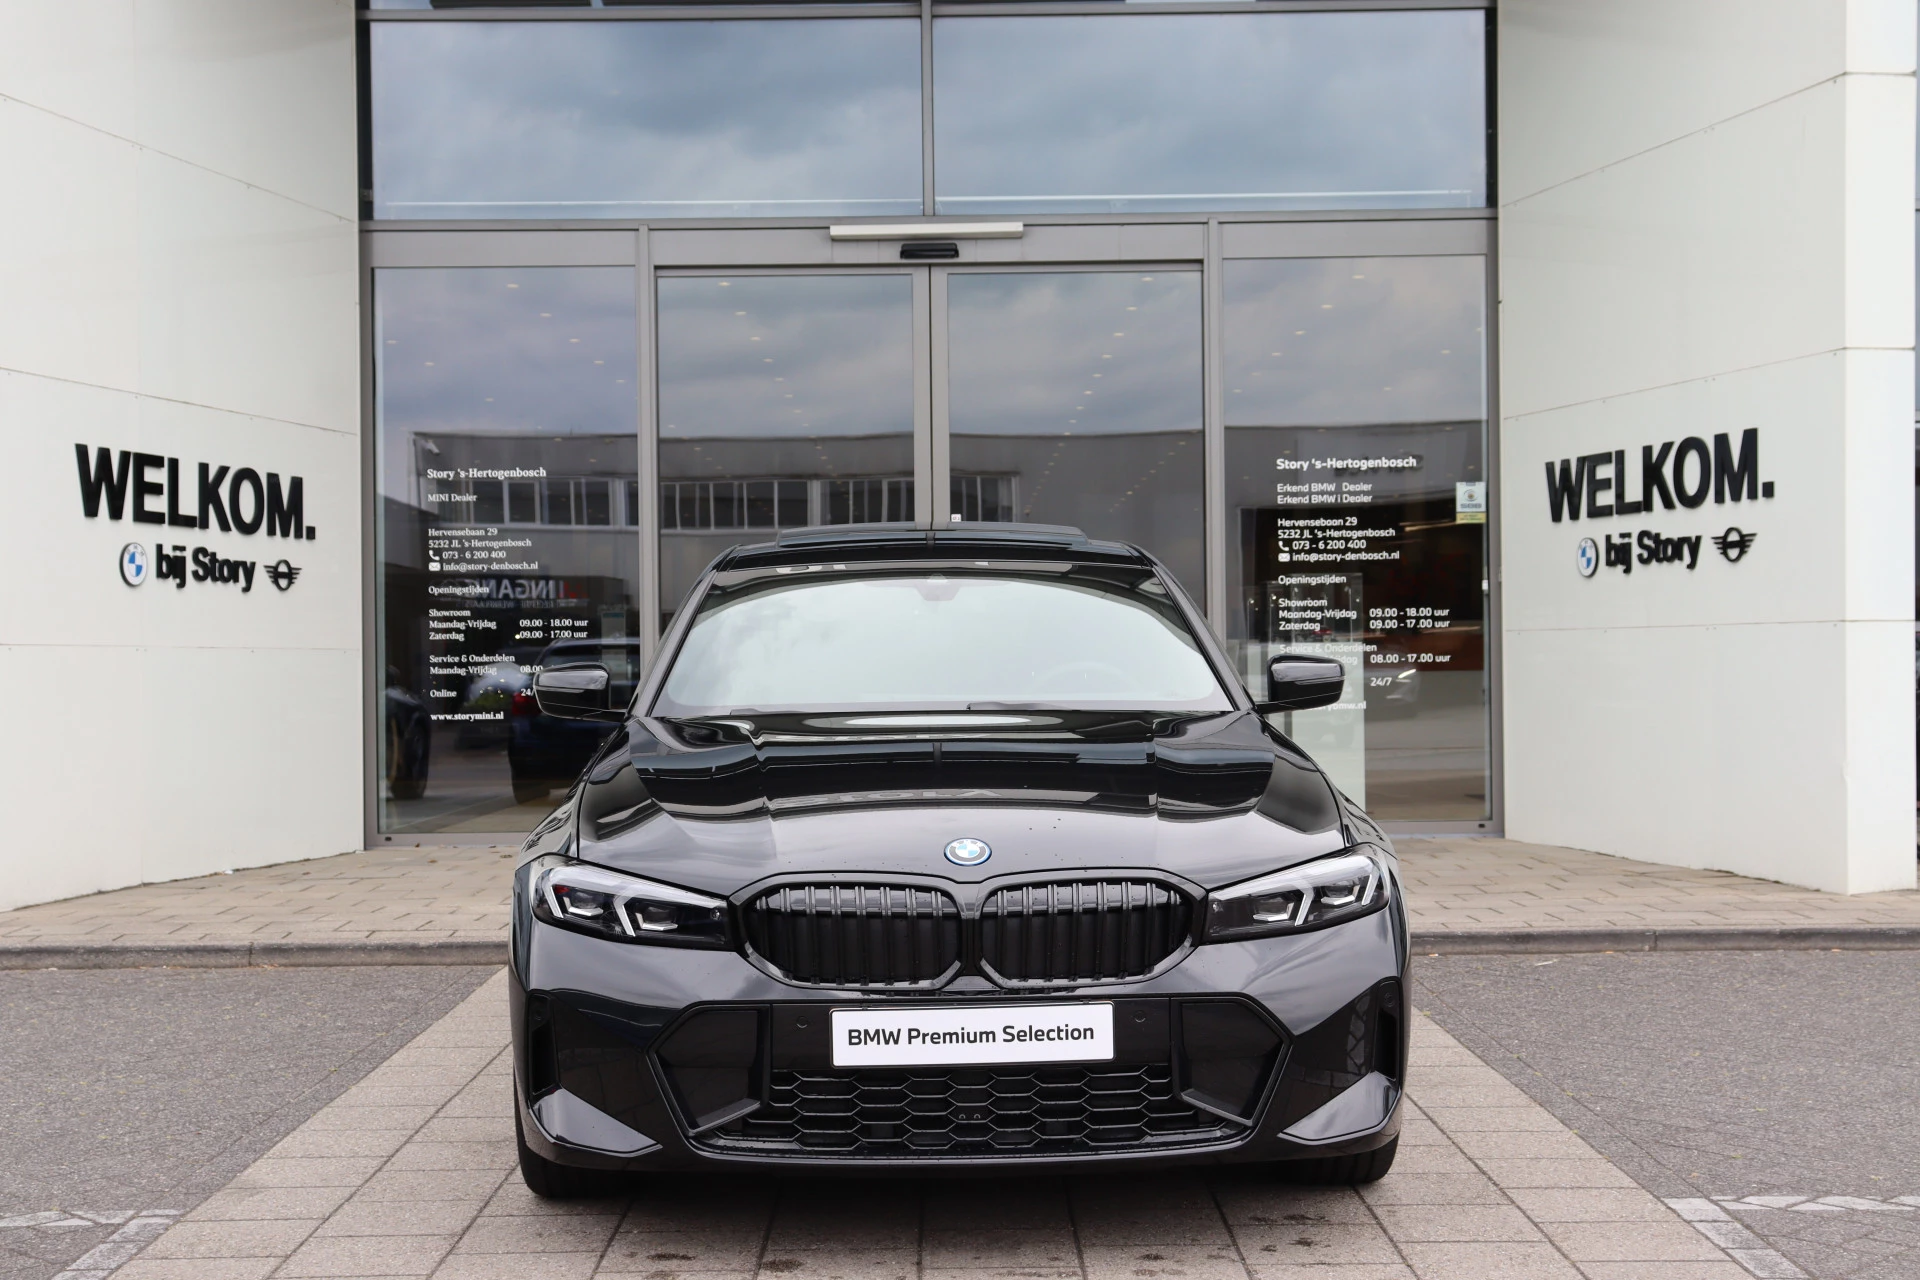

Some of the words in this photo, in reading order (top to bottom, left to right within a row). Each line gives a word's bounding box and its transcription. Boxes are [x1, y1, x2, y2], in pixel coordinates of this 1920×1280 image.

[1276, 458, 1309, 471] Story
[427, 468, 455, 480] Story
[1545, 428, 1775, 523] WELKOM.
[74, 443, 316, 540] WELKOM.
[1277, 484, 1309, 492] Erkend
[1311, 483, 1335, 492] BMW
[1342, 483, 1372, 491] Dealer
[1277, 495, 1309, 504] Erkend
[1311, 495, 1337, 503] BMW
[1343, 494, 1372, 503] Dealer
[1278, 518, 1343, 527] Hervensebaan
[1345, 518, 1357, 526] 29
[1278, 530, 1300, 538] 5232
[1303, 530, 1312, 538] JL
[1293, 541, 1310, 550] 073
[1319, 541, 1324, 549] 6
[1327, 541, 1345, 549] 200
[1347, 540, 1366, 548] 400
[1293, 551, 1400, 562] info@story-denbosch.nl
[1605, 532, 1632, 574] bij
[1637, 530, 1702, 570] Story
[156, 544, 186, 588] bij
[192, 547, 256, 592] Story
[443, 562, 538, 572] info@story-denbosch.nl
[1278, 575, 1346, 585] Openingstijden
[429, 586, 489, 595] Openingstijden
[1279, 610, 1357, 620] Maandag-Vrijdag
[1370, 609, 1397, 617] 09.00
[1406, 608, 1432, 616] 18.00
[429, 620, 496, 629] Maandag-Vrijdag
[1279, 622, 1320, 631] Zaterdag
[1370, 620, 1398, 628] 09.00
[429, 632, 464, 641] Zaterdag
[1280, 645, 1314, 653] Service
[1316, 645, 1322, 653] &
[1370, 655, 1398, 663] 08.00
[430, 666, 497, 675] Maandag-Vrijdag
[1370, 678, 1392, 686] 24/7
[431, 712, 504, 721] www.storymini.nl
[848, 1028, 901, 1045] BMW
[908, 1027, 996, 1044] Premium
[1003, 1024, 1094, 1043] Selection
